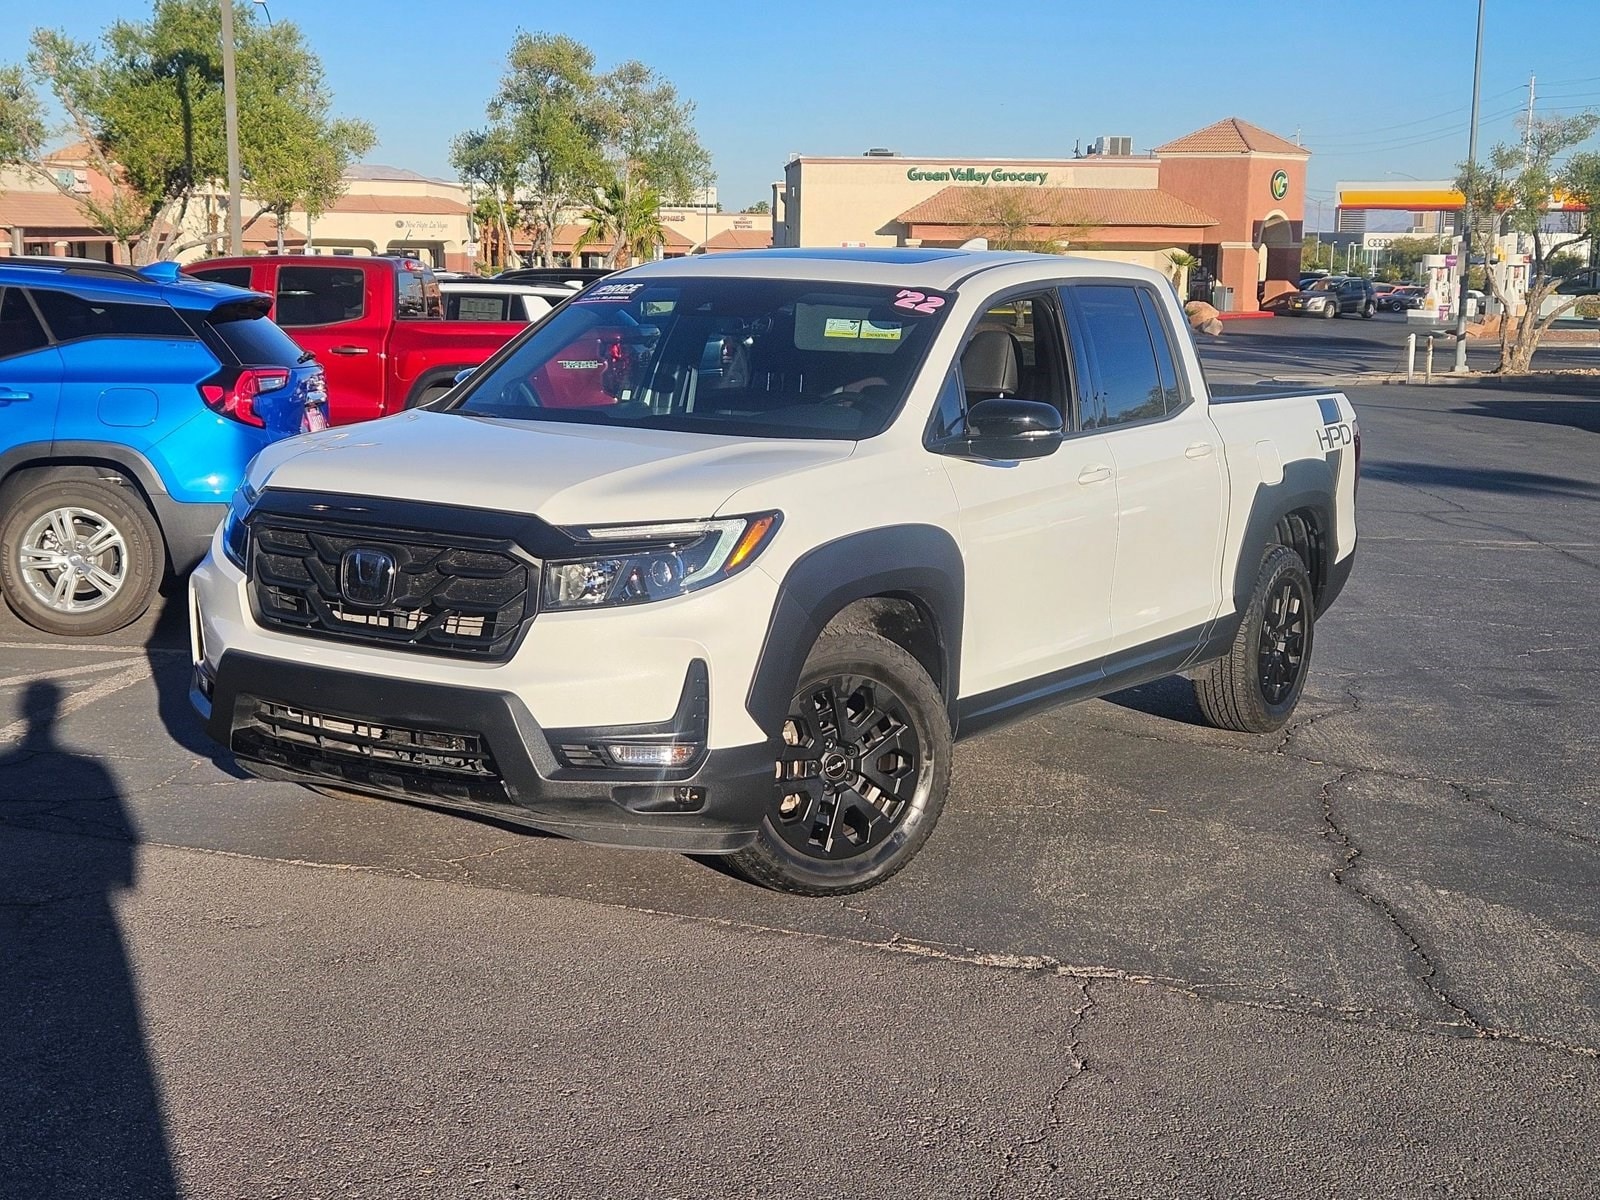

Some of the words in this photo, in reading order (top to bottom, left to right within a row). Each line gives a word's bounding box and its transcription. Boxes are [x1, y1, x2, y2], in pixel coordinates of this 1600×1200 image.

[907, 168, 949, 181] Green
[949, 168, 991, 185] Valley
[991, 168, 1048, 185] Grocery
[1316, 424, 1352, 451] HPD
